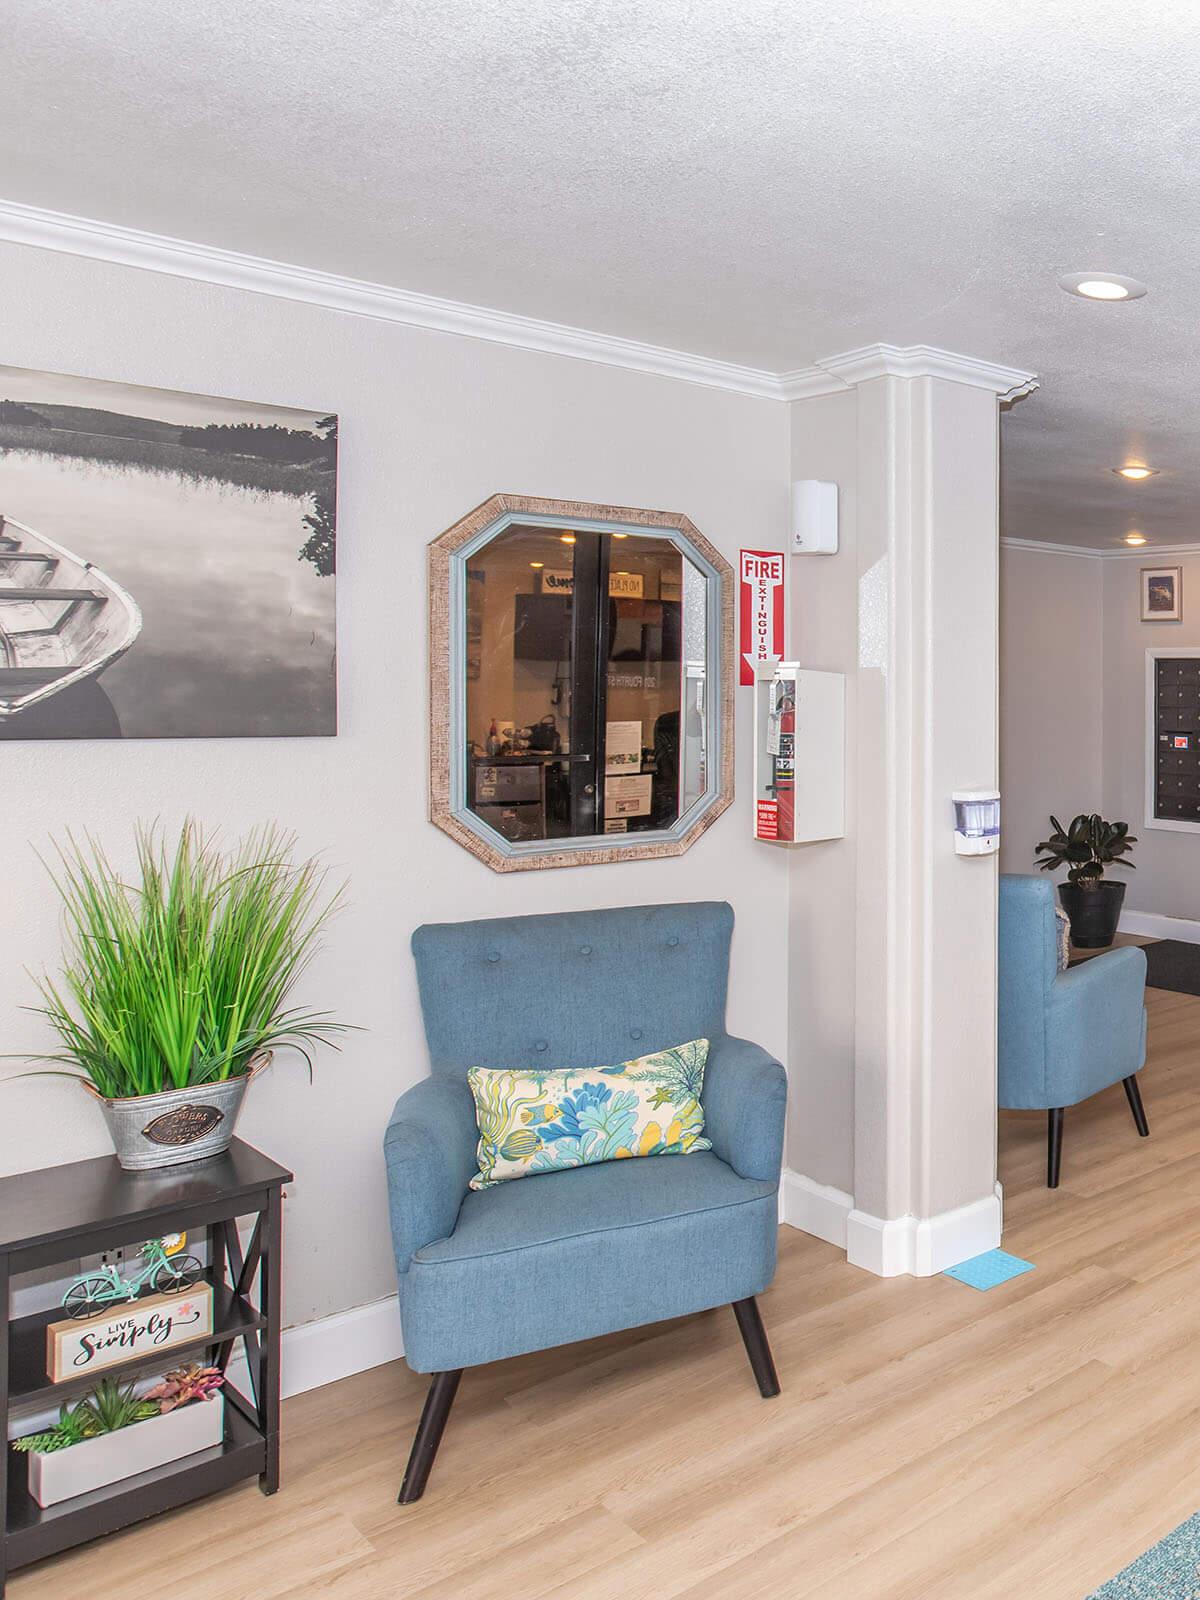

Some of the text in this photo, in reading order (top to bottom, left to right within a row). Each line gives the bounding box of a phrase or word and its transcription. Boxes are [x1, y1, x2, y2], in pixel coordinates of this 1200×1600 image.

[745, 559, 780, 580] FIRE
[757, 579, 768, 660] EXTINGUISH
[73, 1313, 200, 1366] Simply
[108, 1319, 136, 1334] LIVE
